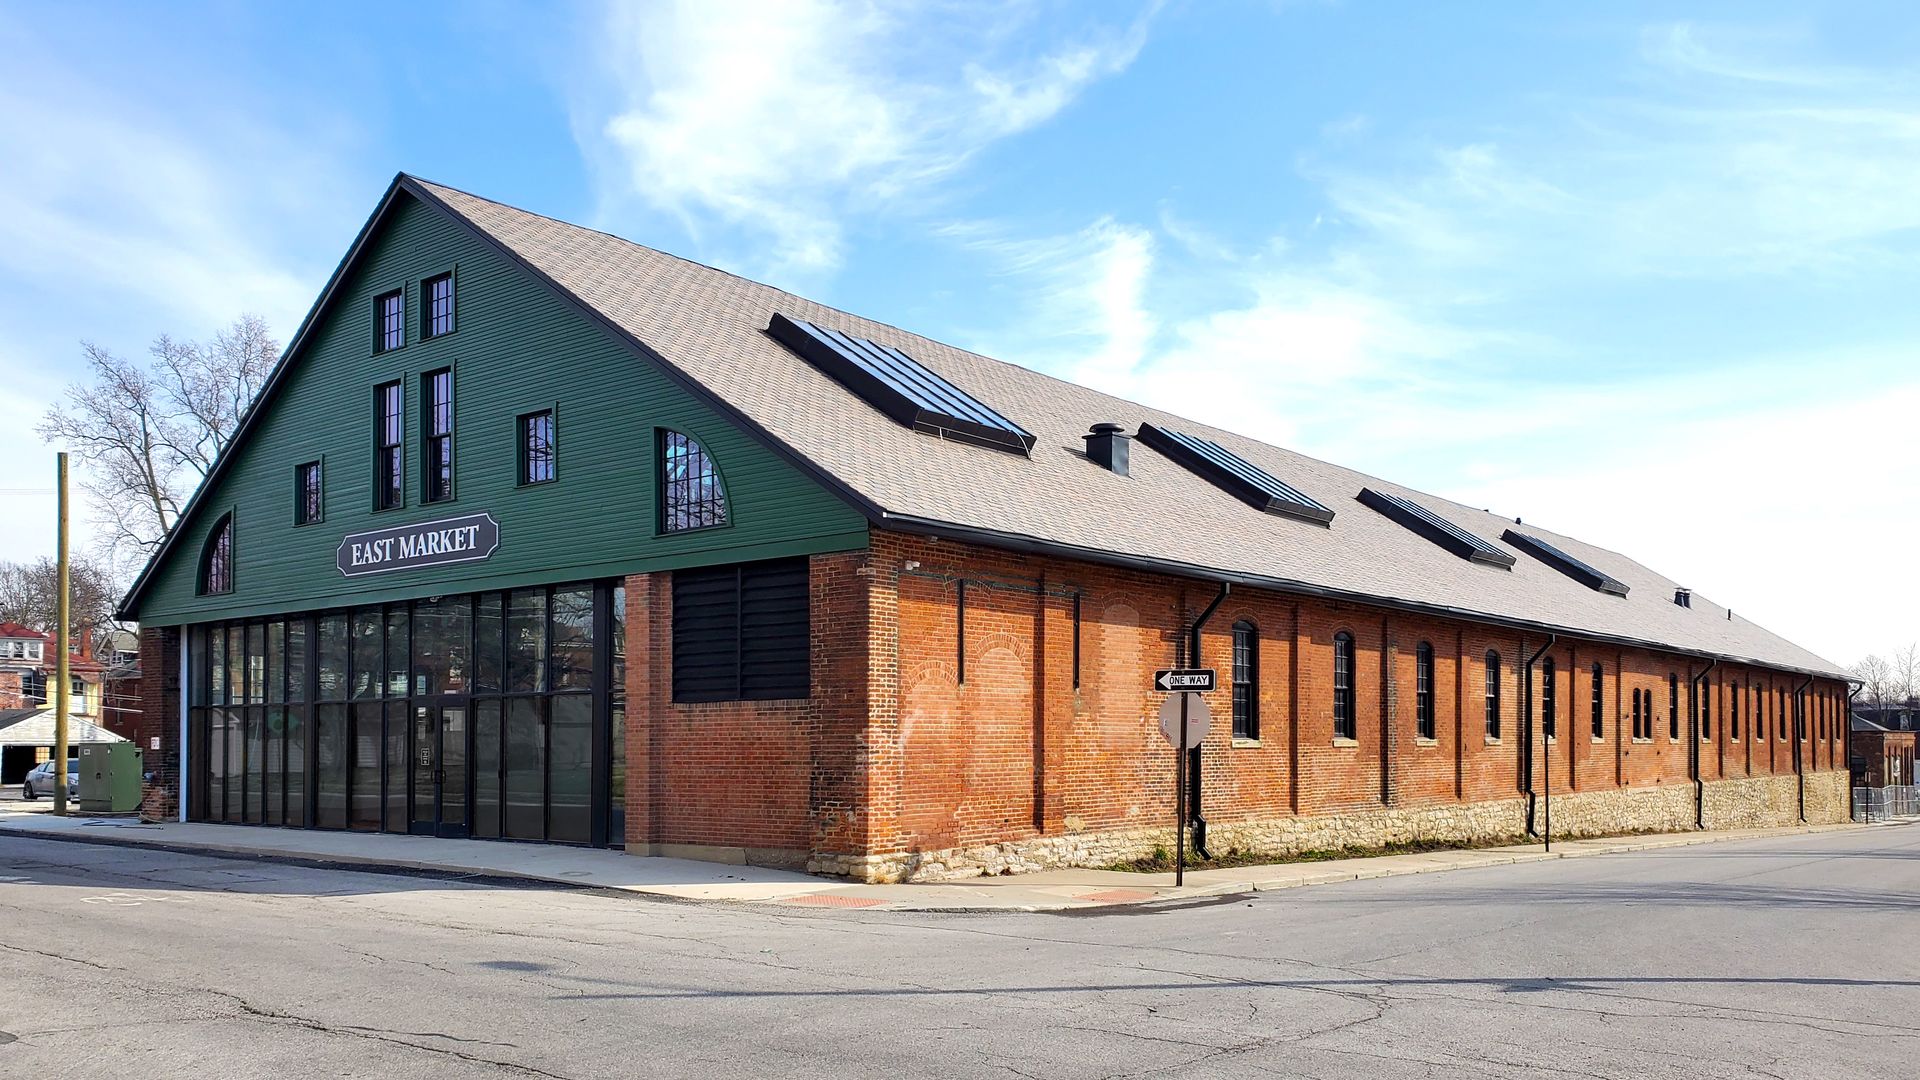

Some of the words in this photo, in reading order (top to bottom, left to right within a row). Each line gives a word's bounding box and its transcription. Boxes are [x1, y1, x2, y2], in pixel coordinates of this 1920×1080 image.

[351, 537, 394, 566] EAST
[398, 524, 480, 559] MARKET
[1169, 676, 1185, 685] ONE
[1189, 675, 1207, 685] WAY
